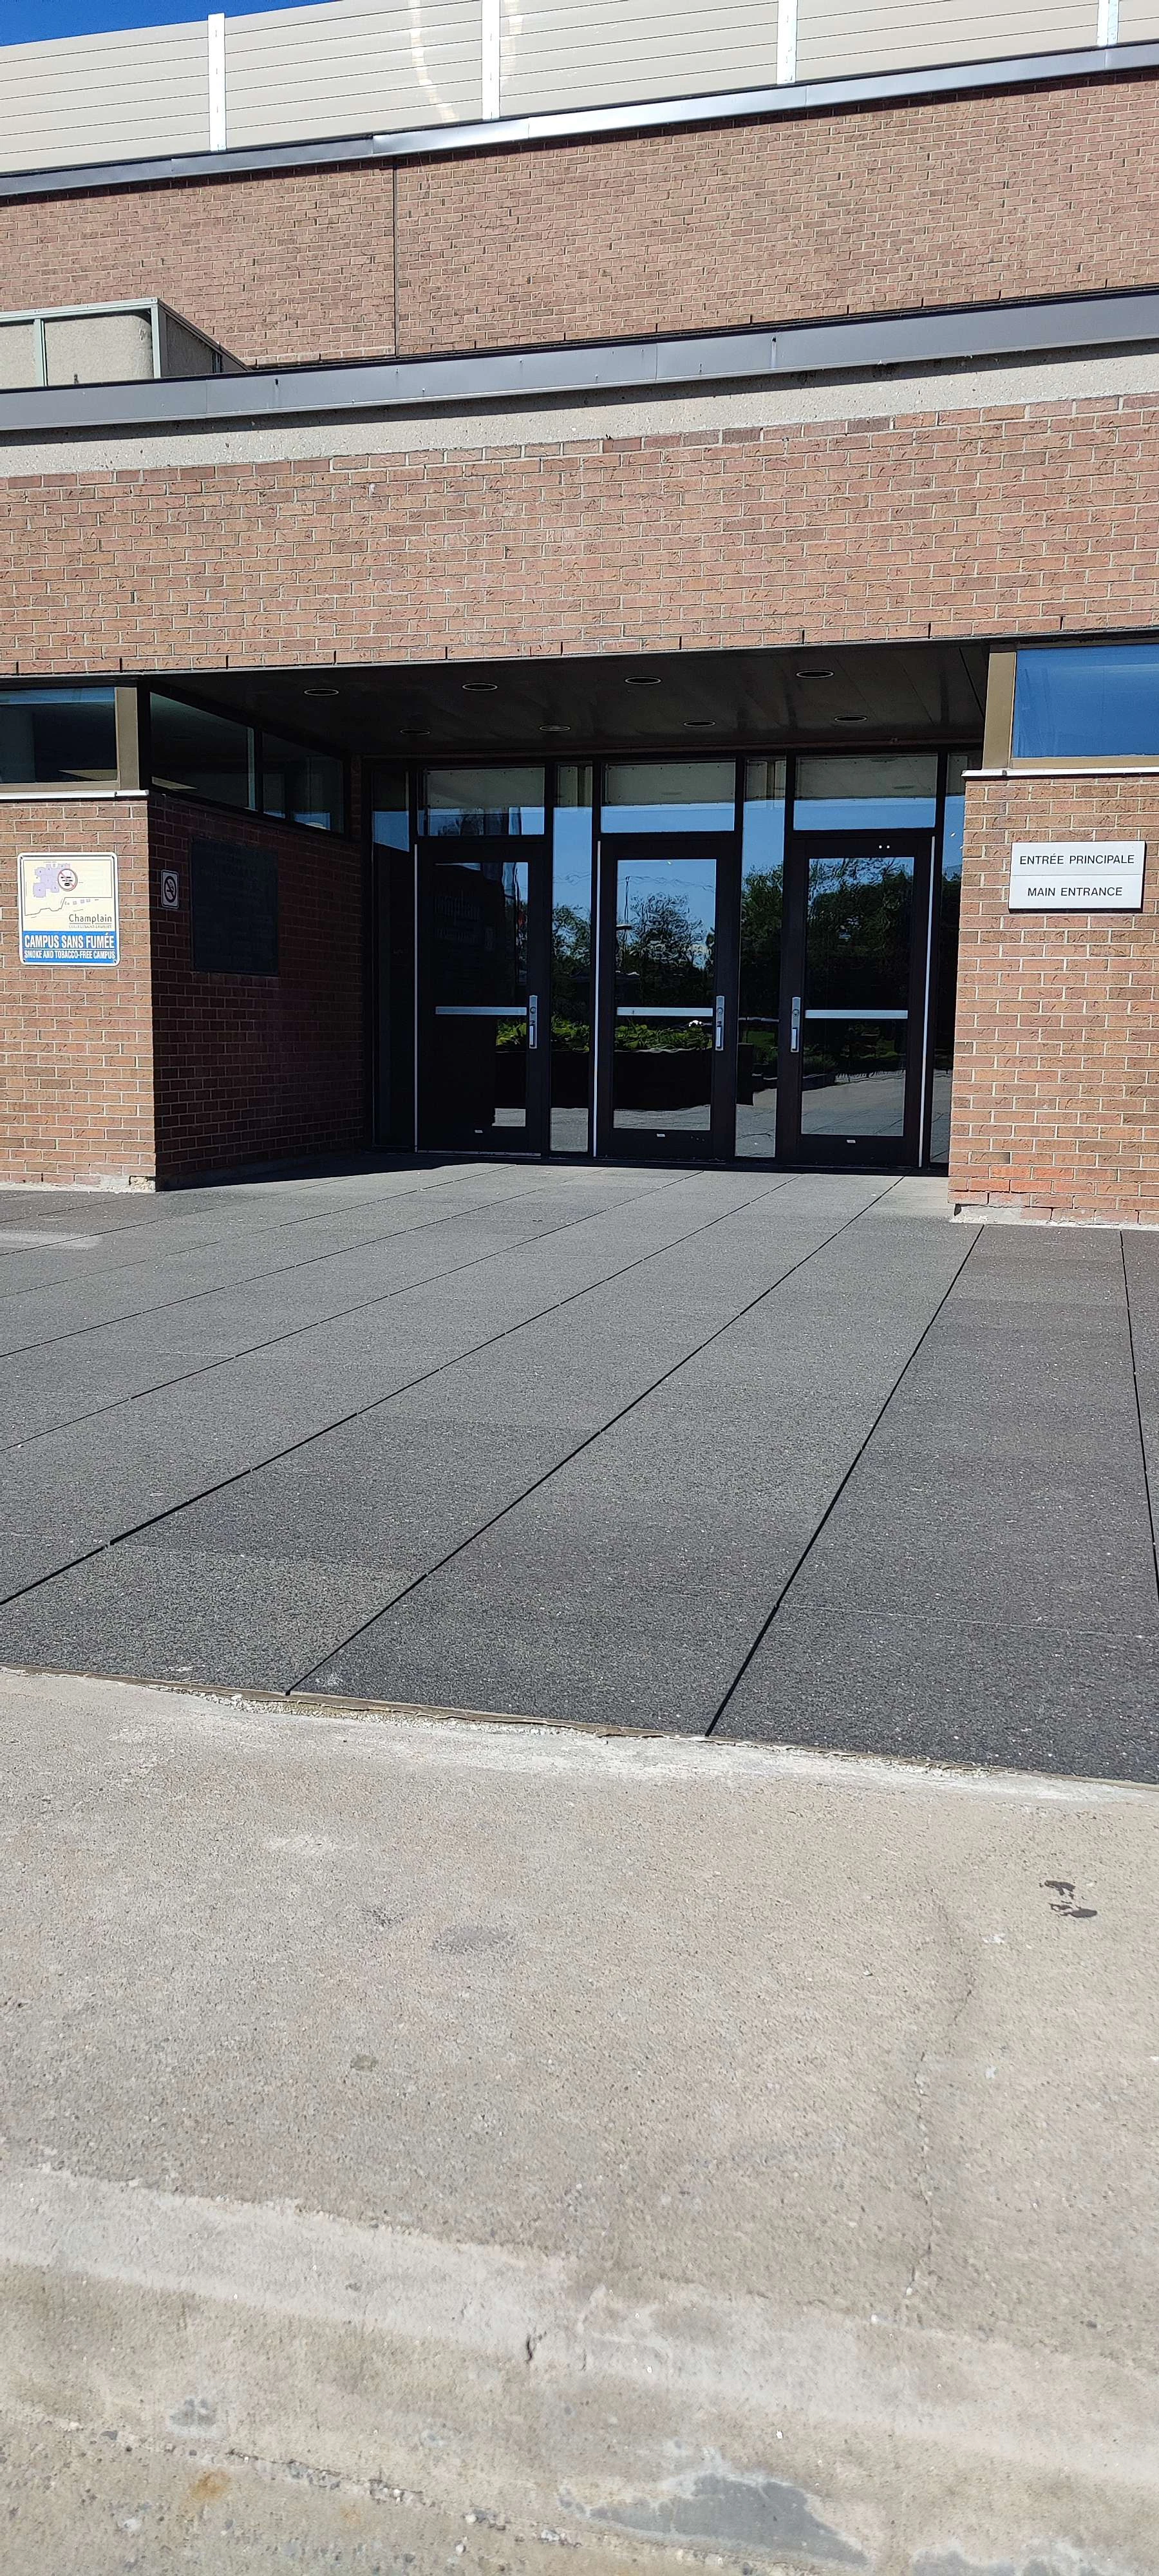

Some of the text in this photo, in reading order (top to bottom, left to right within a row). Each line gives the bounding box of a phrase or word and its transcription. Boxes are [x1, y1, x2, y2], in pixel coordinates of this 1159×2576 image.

[1020, 853, 1135, 864] ENTRÉE PRINCIPALE
[1028, 887, 1123, 896] MAIN ENTRANCE
[69, 913, 112, 925] Champlain
[24, 933, 115, 949] CAMPUS SANS FUMÉE
[24, 950, 115, 959] SMOKE AND TOBACCO-FREE CAMPUS
